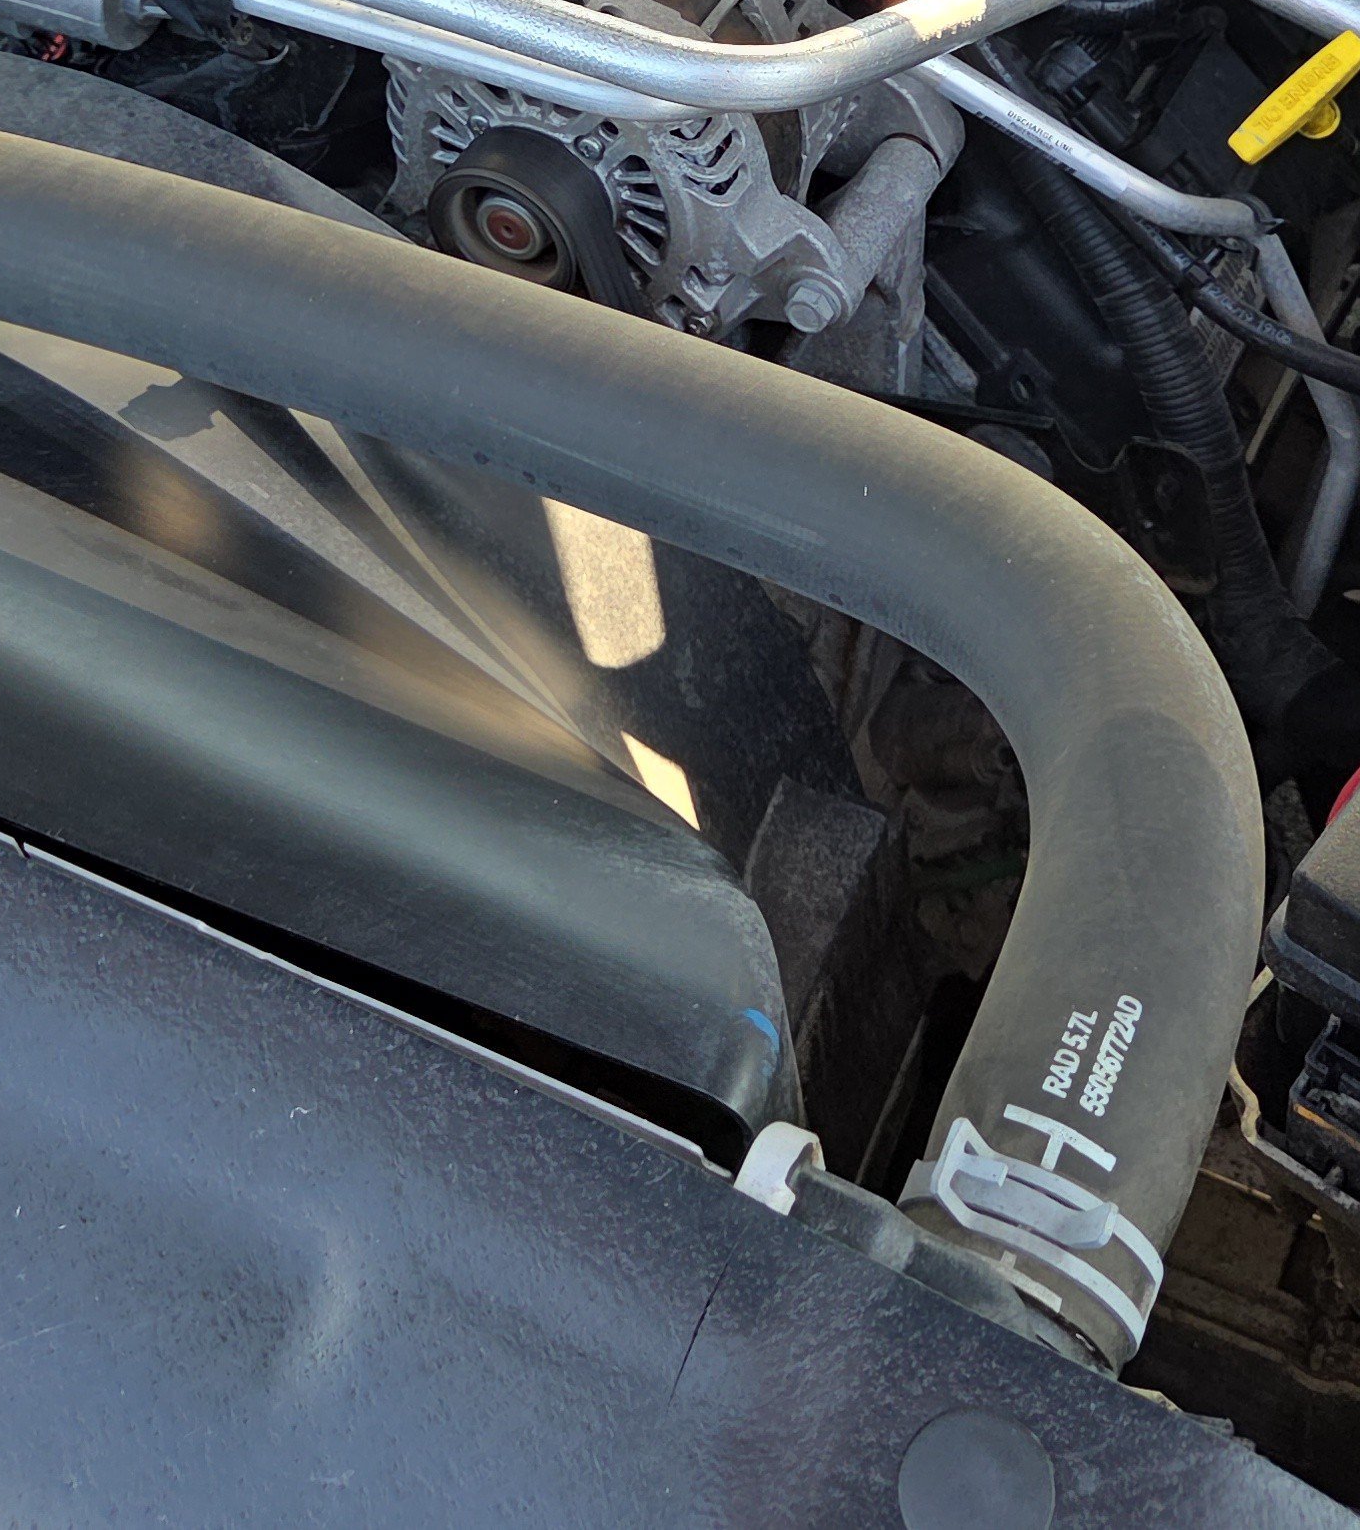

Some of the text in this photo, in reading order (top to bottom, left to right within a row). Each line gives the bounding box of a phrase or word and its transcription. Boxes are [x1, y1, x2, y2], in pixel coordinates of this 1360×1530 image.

[1252, 53, 1342, 131] ENGINE OIL
[1007, 110, 1054, 142] DISCHARGE
[1055, 139, 1074, 155] LINE
[1042, 1010, 1099, 1099] RAD 5.7L
